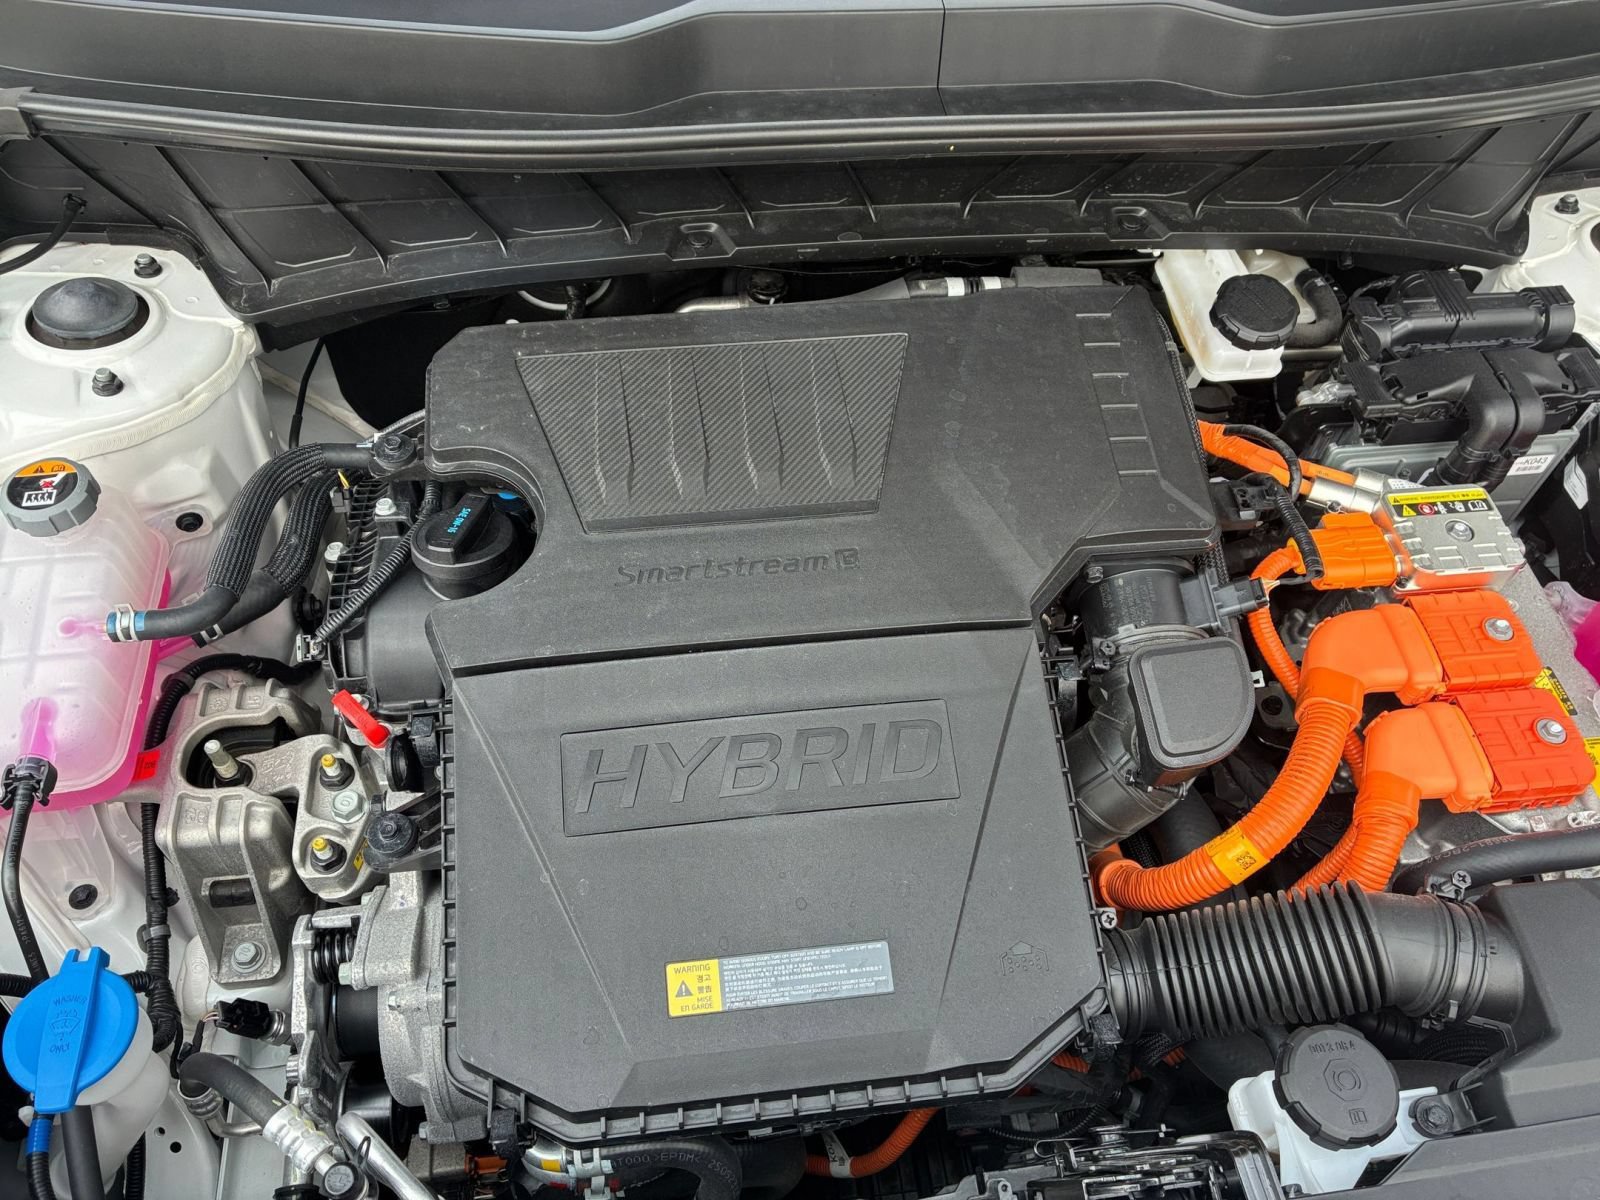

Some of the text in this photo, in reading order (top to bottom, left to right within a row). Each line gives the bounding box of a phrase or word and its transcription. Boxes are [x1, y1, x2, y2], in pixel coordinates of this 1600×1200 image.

[613, 553, 831, 588] Smartstream
[574, 718, 943, 814] HYBRID
[673, 963, 711, 975] WARNING
[691, 1002, 713, 1011] GARDE
